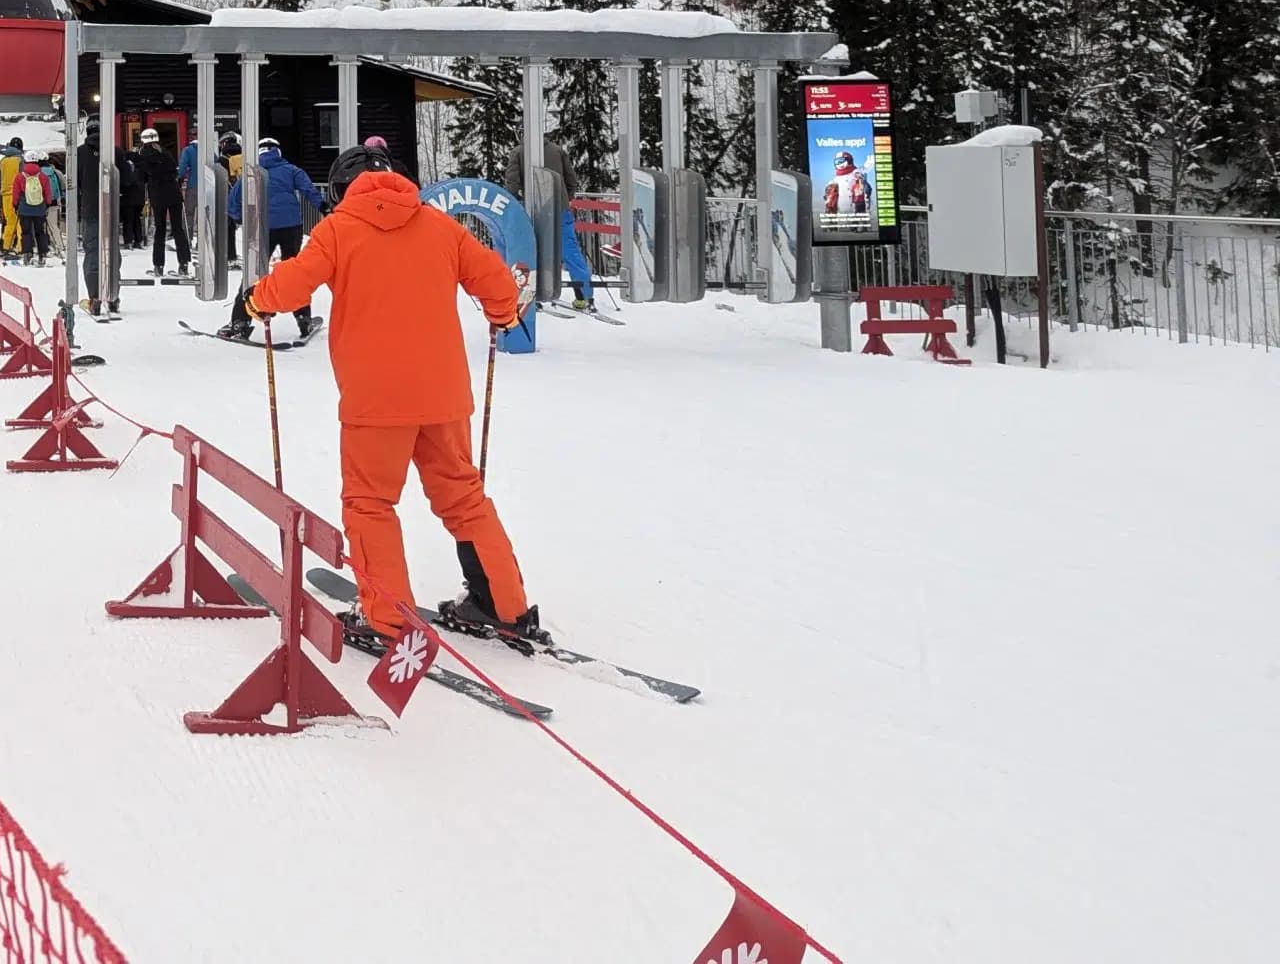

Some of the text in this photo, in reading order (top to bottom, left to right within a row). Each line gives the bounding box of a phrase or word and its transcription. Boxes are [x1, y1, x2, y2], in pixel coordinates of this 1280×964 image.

[815, 137, 867, 149] Valles app!
[428, 185, 510, 216] VALLE
